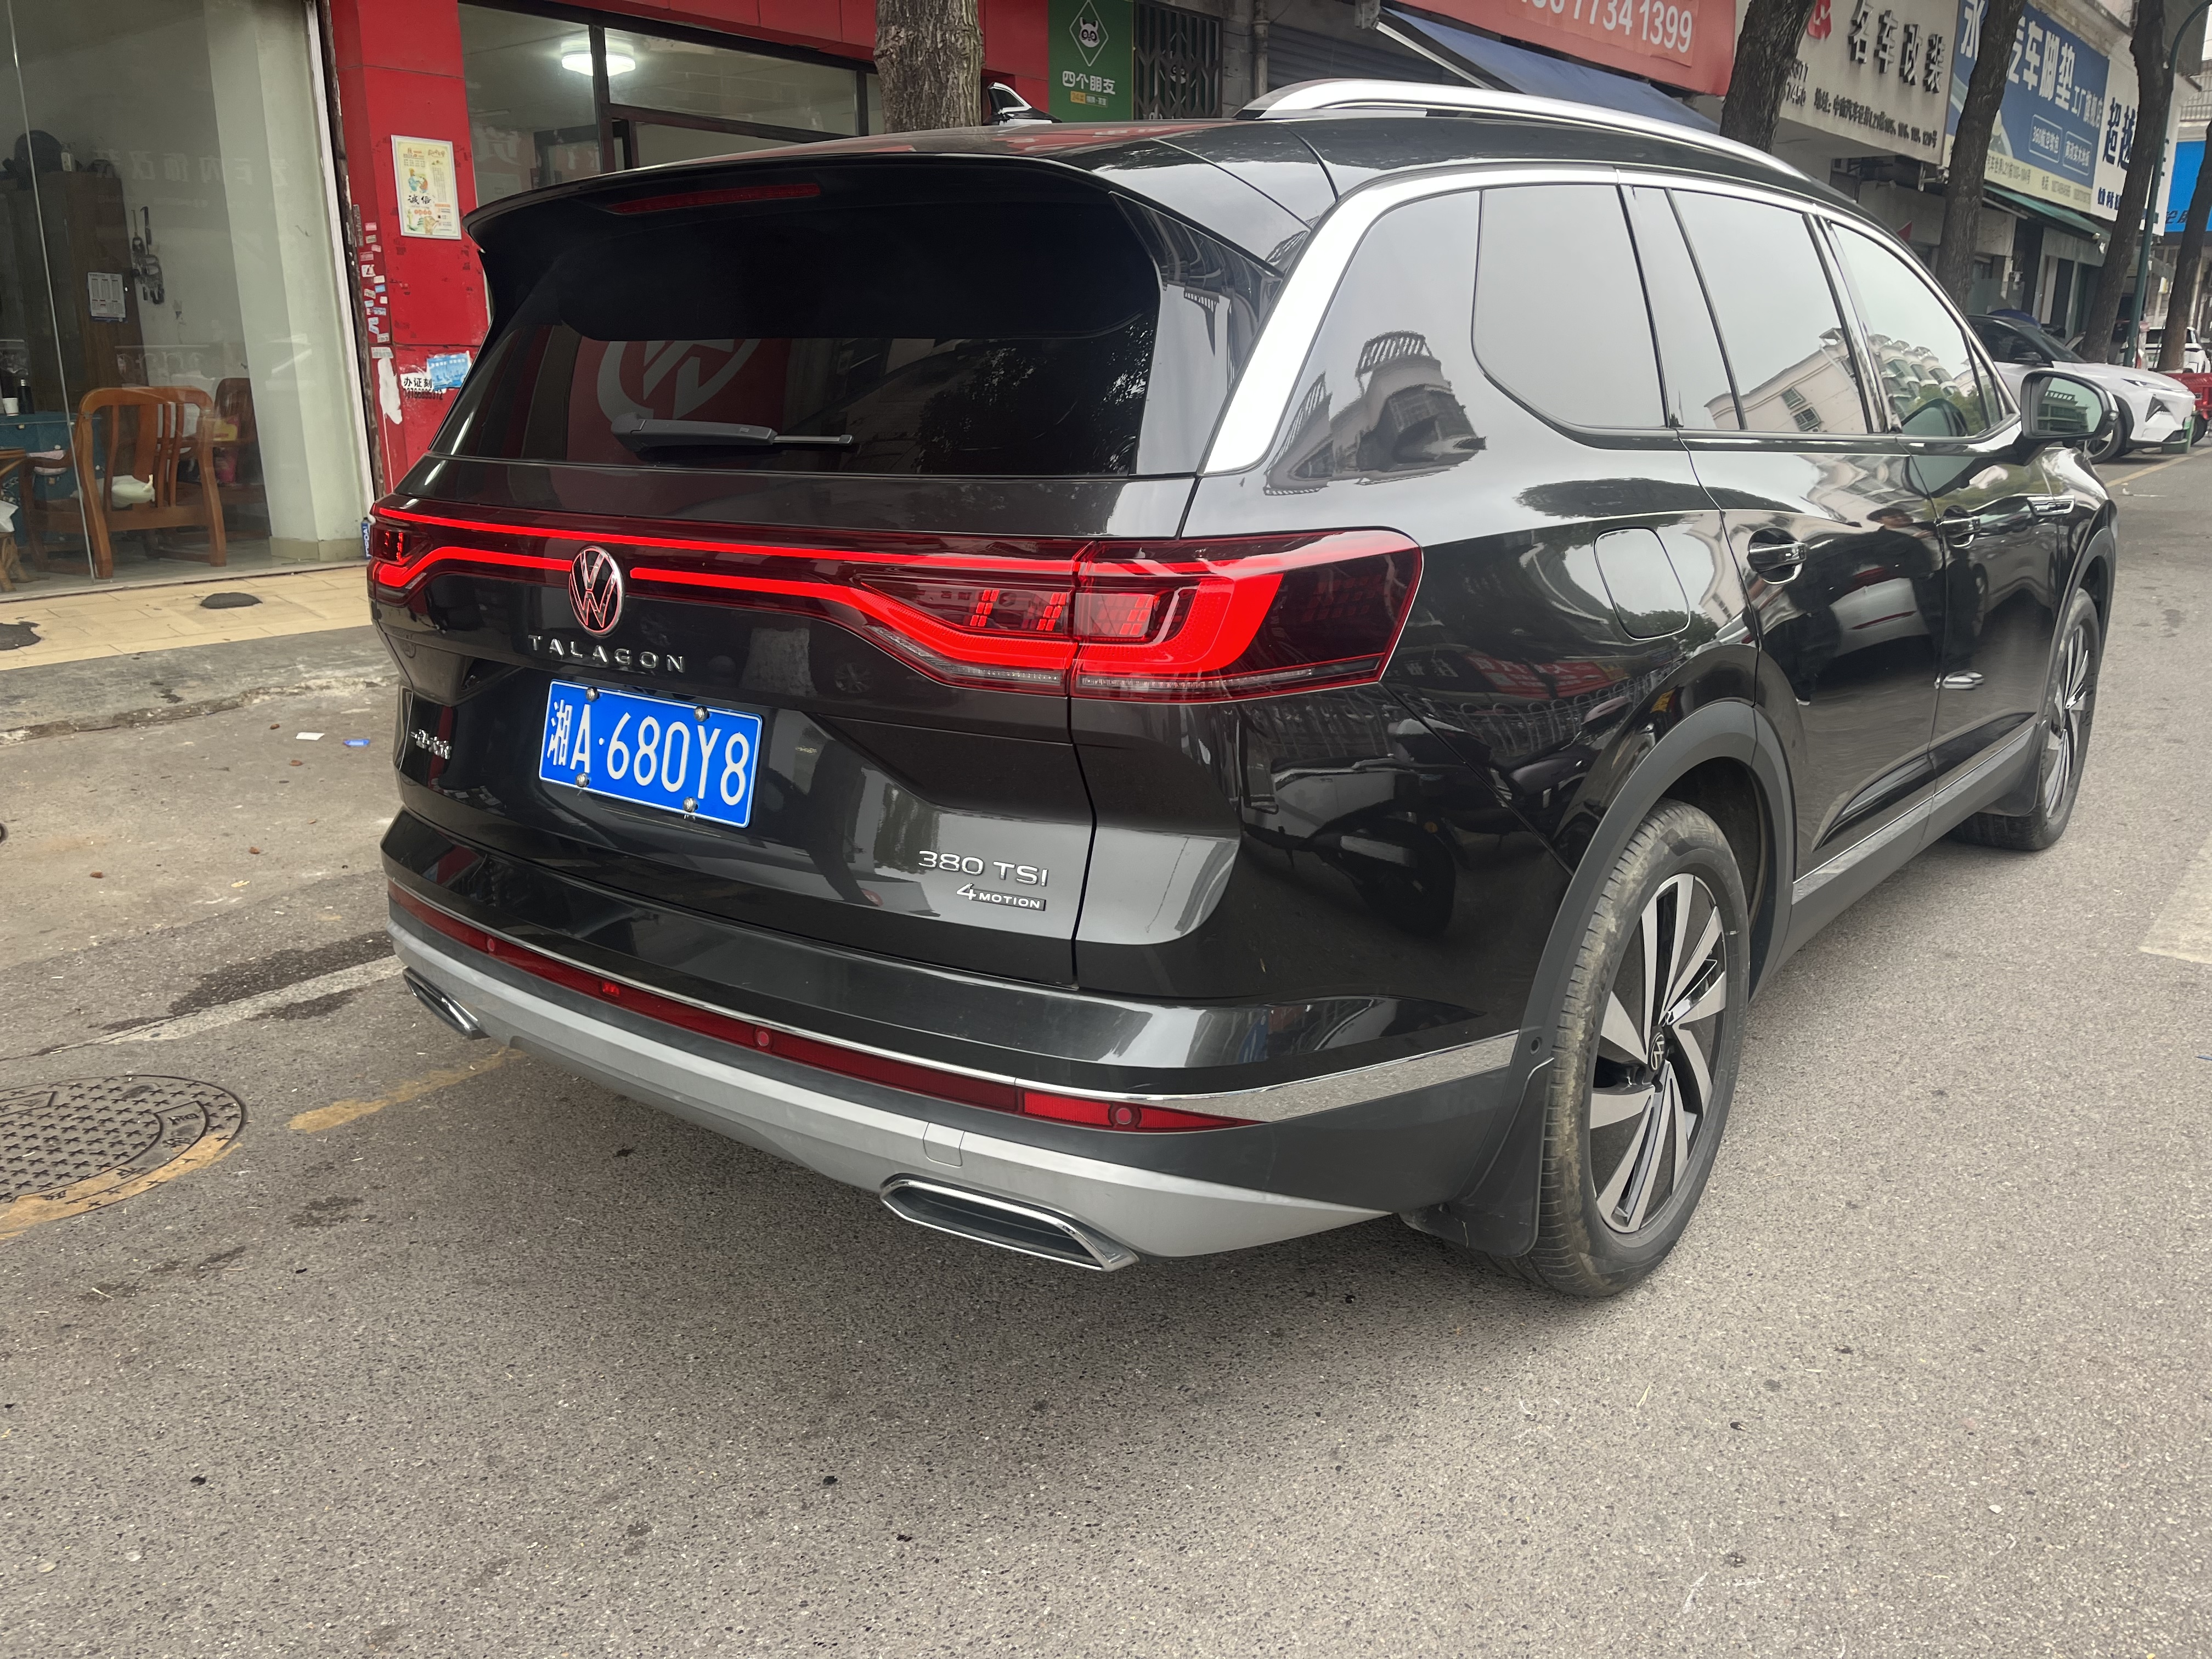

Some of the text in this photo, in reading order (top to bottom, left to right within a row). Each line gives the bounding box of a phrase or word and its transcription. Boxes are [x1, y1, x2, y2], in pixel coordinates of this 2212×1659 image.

[1847, 0, 1944, 93] 名车改装
[1062, 70, 1116, 95] 四个朋友
[528, 634, 685, 673] TALAGON
[918, 850, 1049, 887] 380 TSI
[956, 882, 1041, 909] 4MOTION
